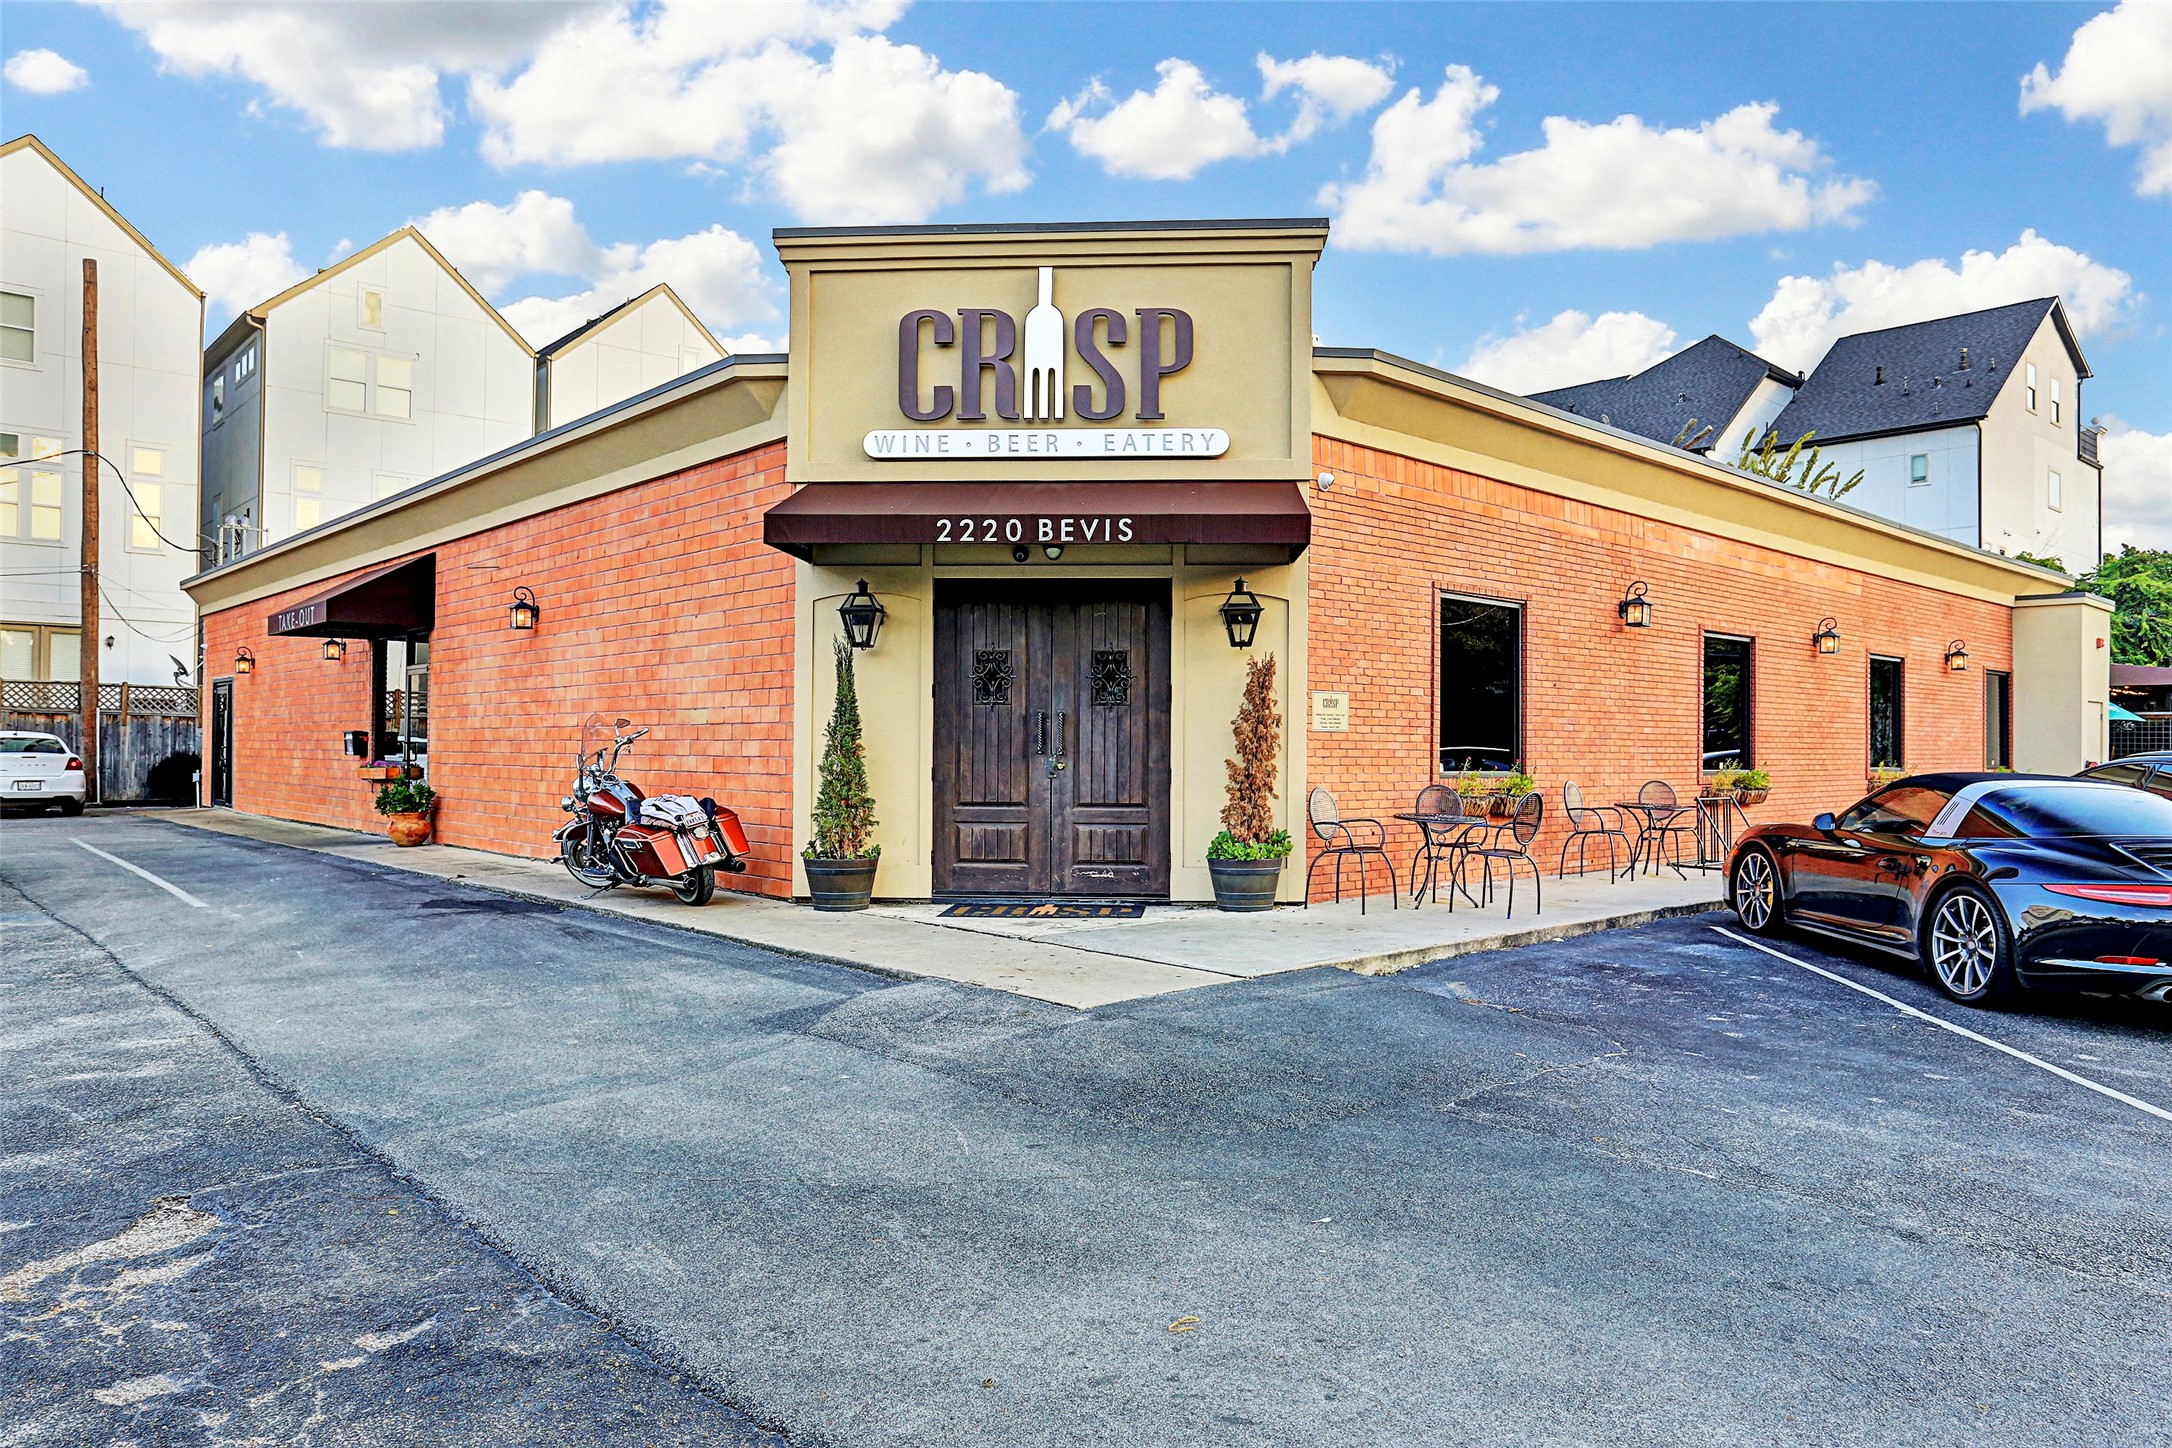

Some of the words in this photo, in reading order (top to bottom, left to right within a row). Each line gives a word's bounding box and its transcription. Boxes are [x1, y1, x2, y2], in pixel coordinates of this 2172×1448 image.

[898, 304, 1194, 422] CRISP
[873, 434, 950, 454] WINE
[987, 433, 1059, 453] BEER
[1103, 432, 1216, 453] EATERY
[935, 517, 1024, 543] 2220
[1037, 517, 1134, 543] BEVIS
[278, 605, 315, 632] TAKE-OUT
